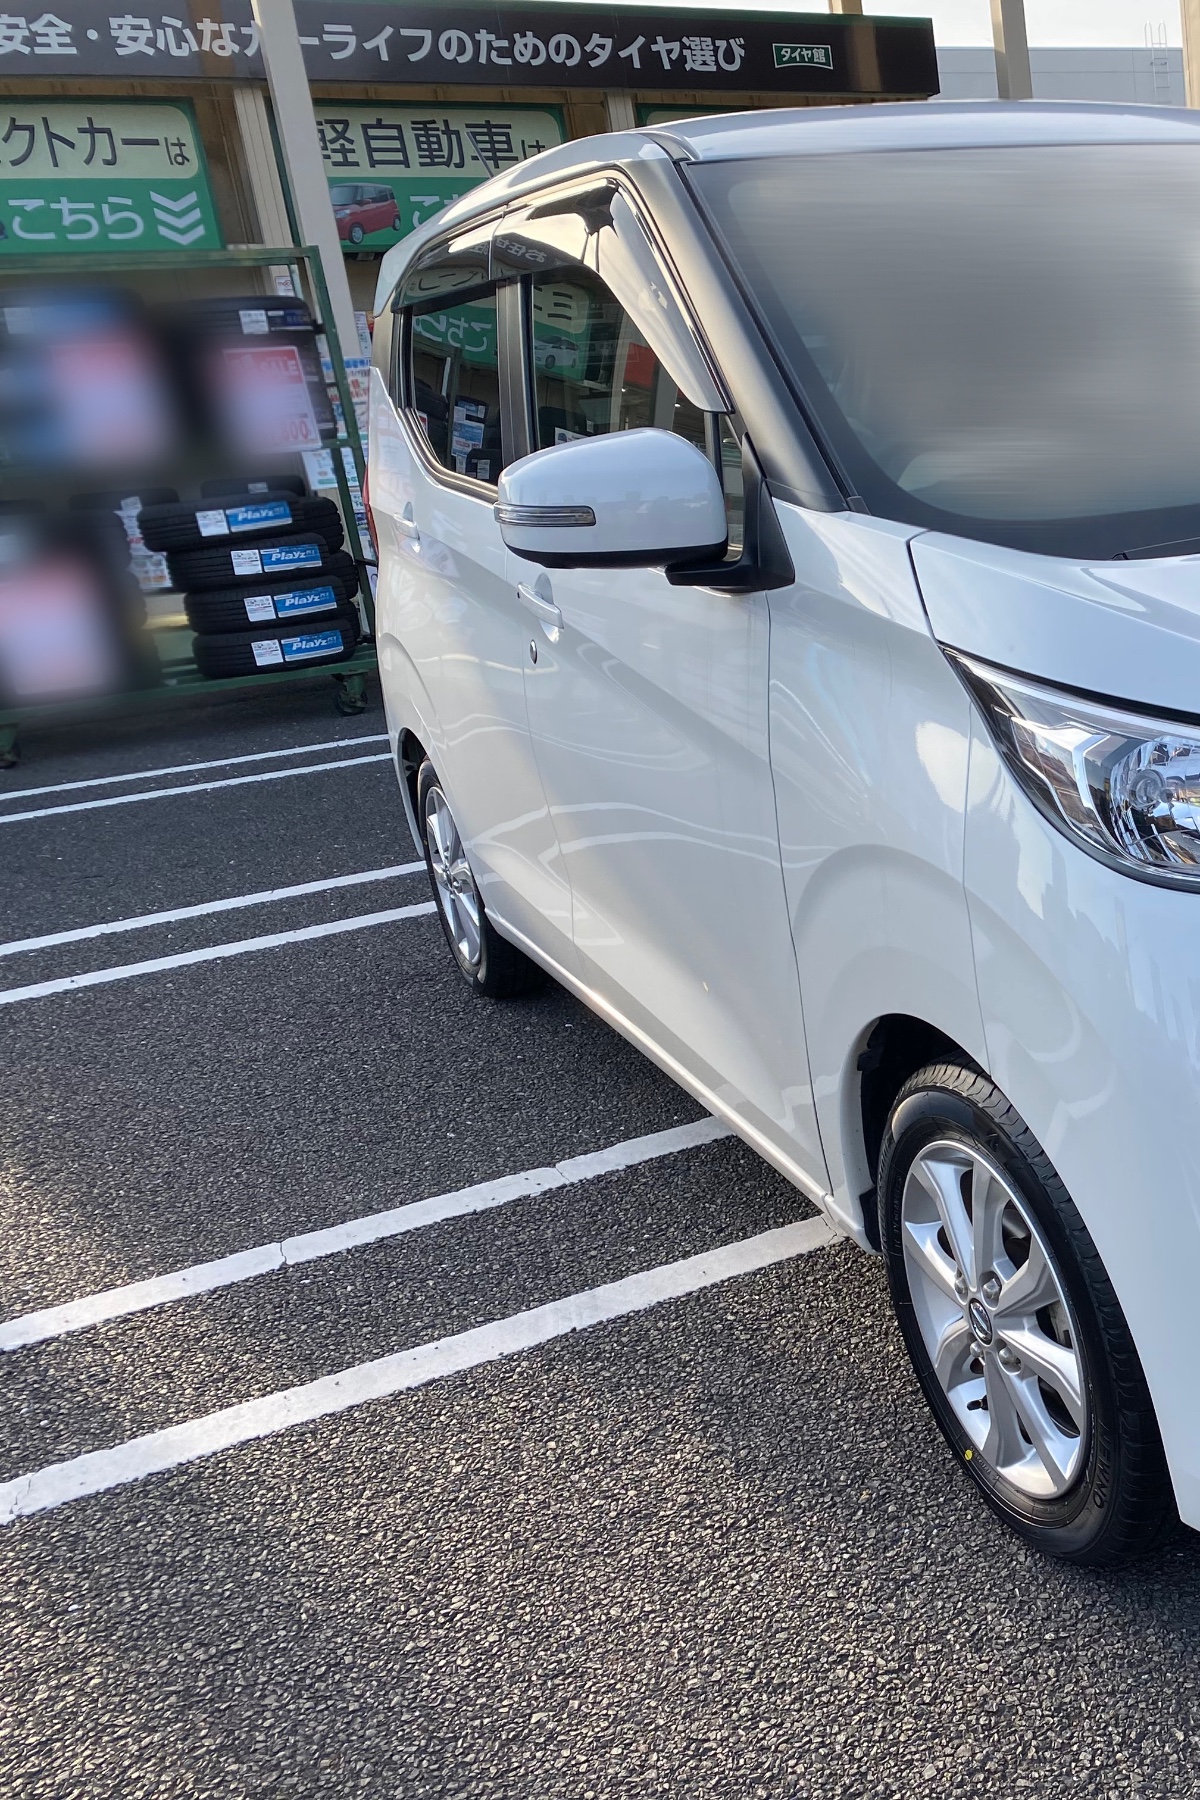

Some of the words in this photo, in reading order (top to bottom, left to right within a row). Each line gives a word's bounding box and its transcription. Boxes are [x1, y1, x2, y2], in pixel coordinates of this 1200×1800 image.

[781, 47, 826, 63] タイヤ館
[0, 116, 190, 168] クトカーは
[8, 196, 144, 240] こちら
[270, 550, 307, 562] Playz
[284, 594, 320, 607] Playz
[291, 638, 328, 651] Playz
